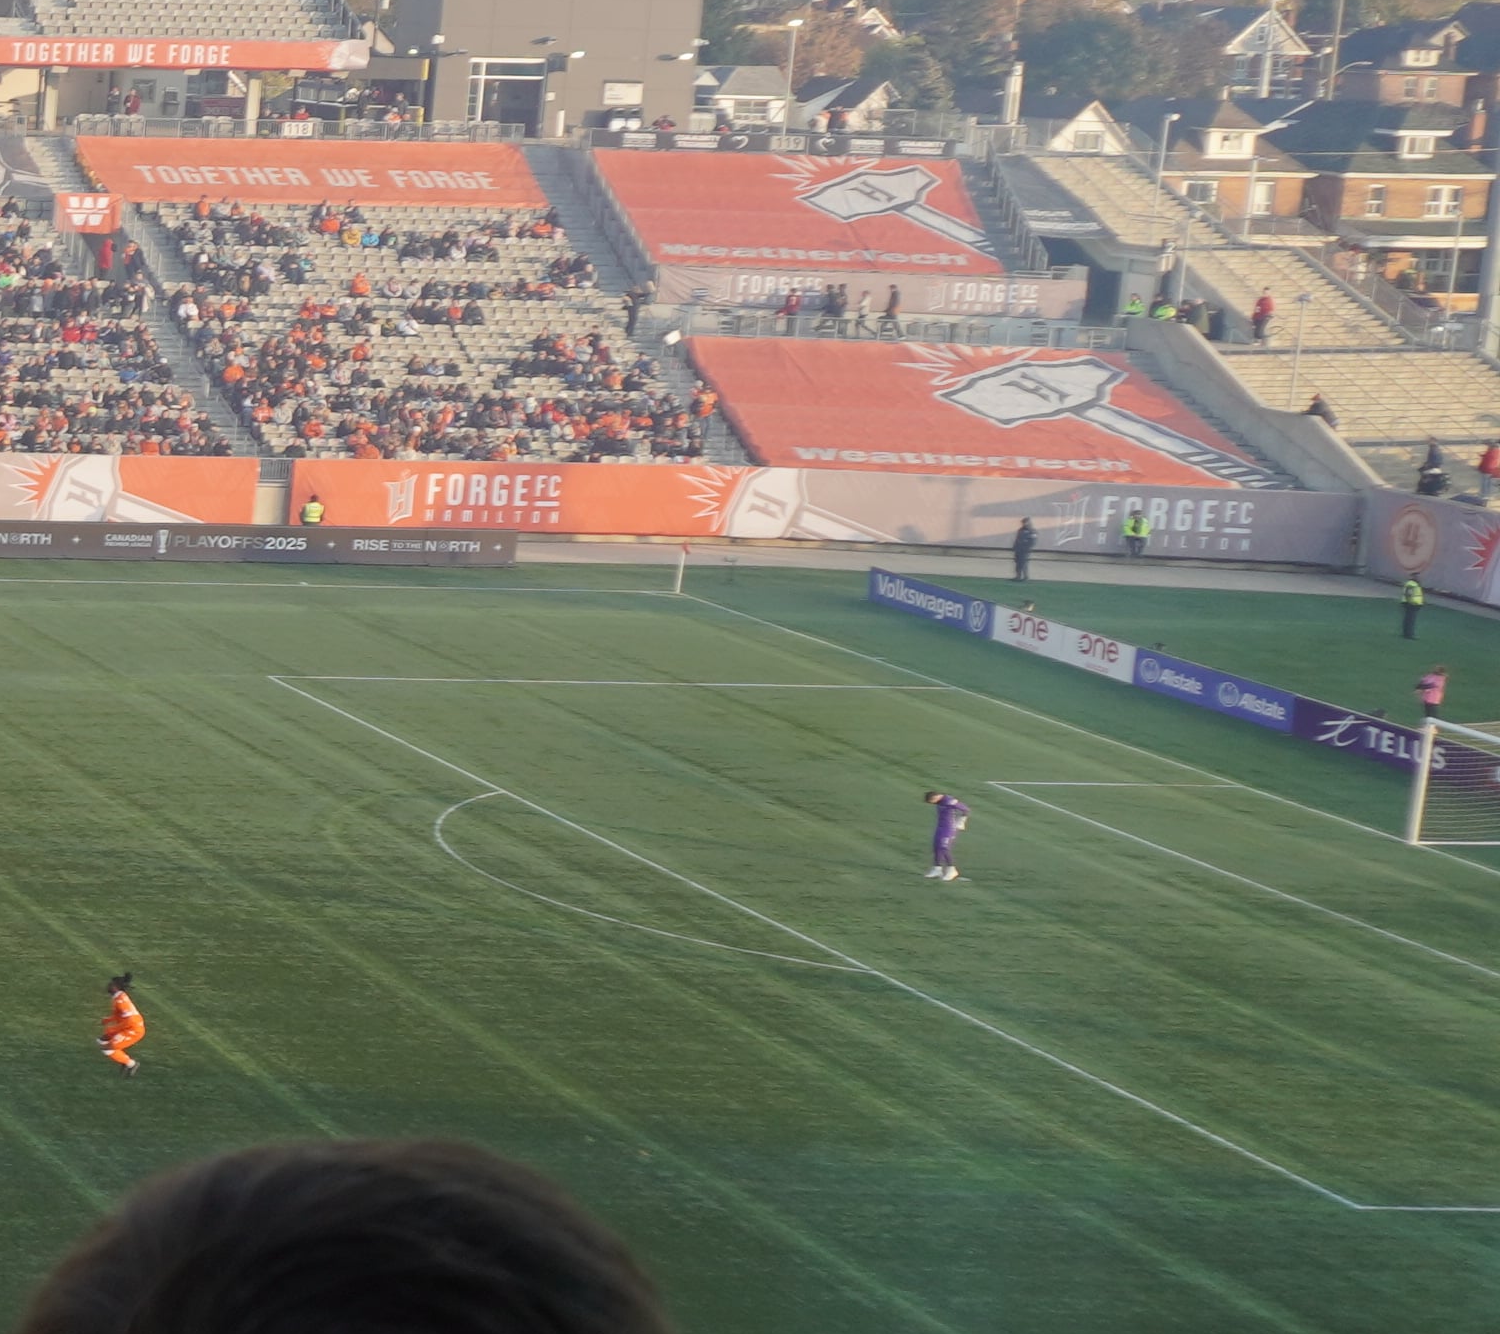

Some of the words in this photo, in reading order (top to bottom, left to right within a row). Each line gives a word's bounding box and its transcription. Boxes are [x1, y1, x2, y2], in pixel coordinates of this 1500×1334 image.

[11, 41, 115, 63] TOGETHER
[127, 43, 157, 63] WE
[169, 44, 230, 65] FORGE
[287, 123, 309, 135] 118
[134, 165, 312, 186] TOGETHER
[322, 167, 380, 188] WE
[387, 169, 498, 190] FORGE
[661, 243, 970, 266] WeatherTech
[953, 281, 1019, 304] FORGE
[793, 447, 1133, 472] WeatherTech
[424, 472, 532, 507] FORGE
[535, 474, 562, 498] FC
[424, 509, 560, 524] HAMILTON
[1100, 494, 1220, 534] FORGE
[1225, 499, 1254, 525] FC
[105, 533, 153, 542] CANADIAN
[353, 538, 389, 551] RISE
[875, 572, 964, 620] Volkswagen
[1007, 611, 1049, 643] one
[1079, 632, 1119, 663] one
[1159, 668, 1204, 695] Allstate
[1238, 692, 1286, 721] Allstate
[1363, 725, 1446, 770] TELUS
